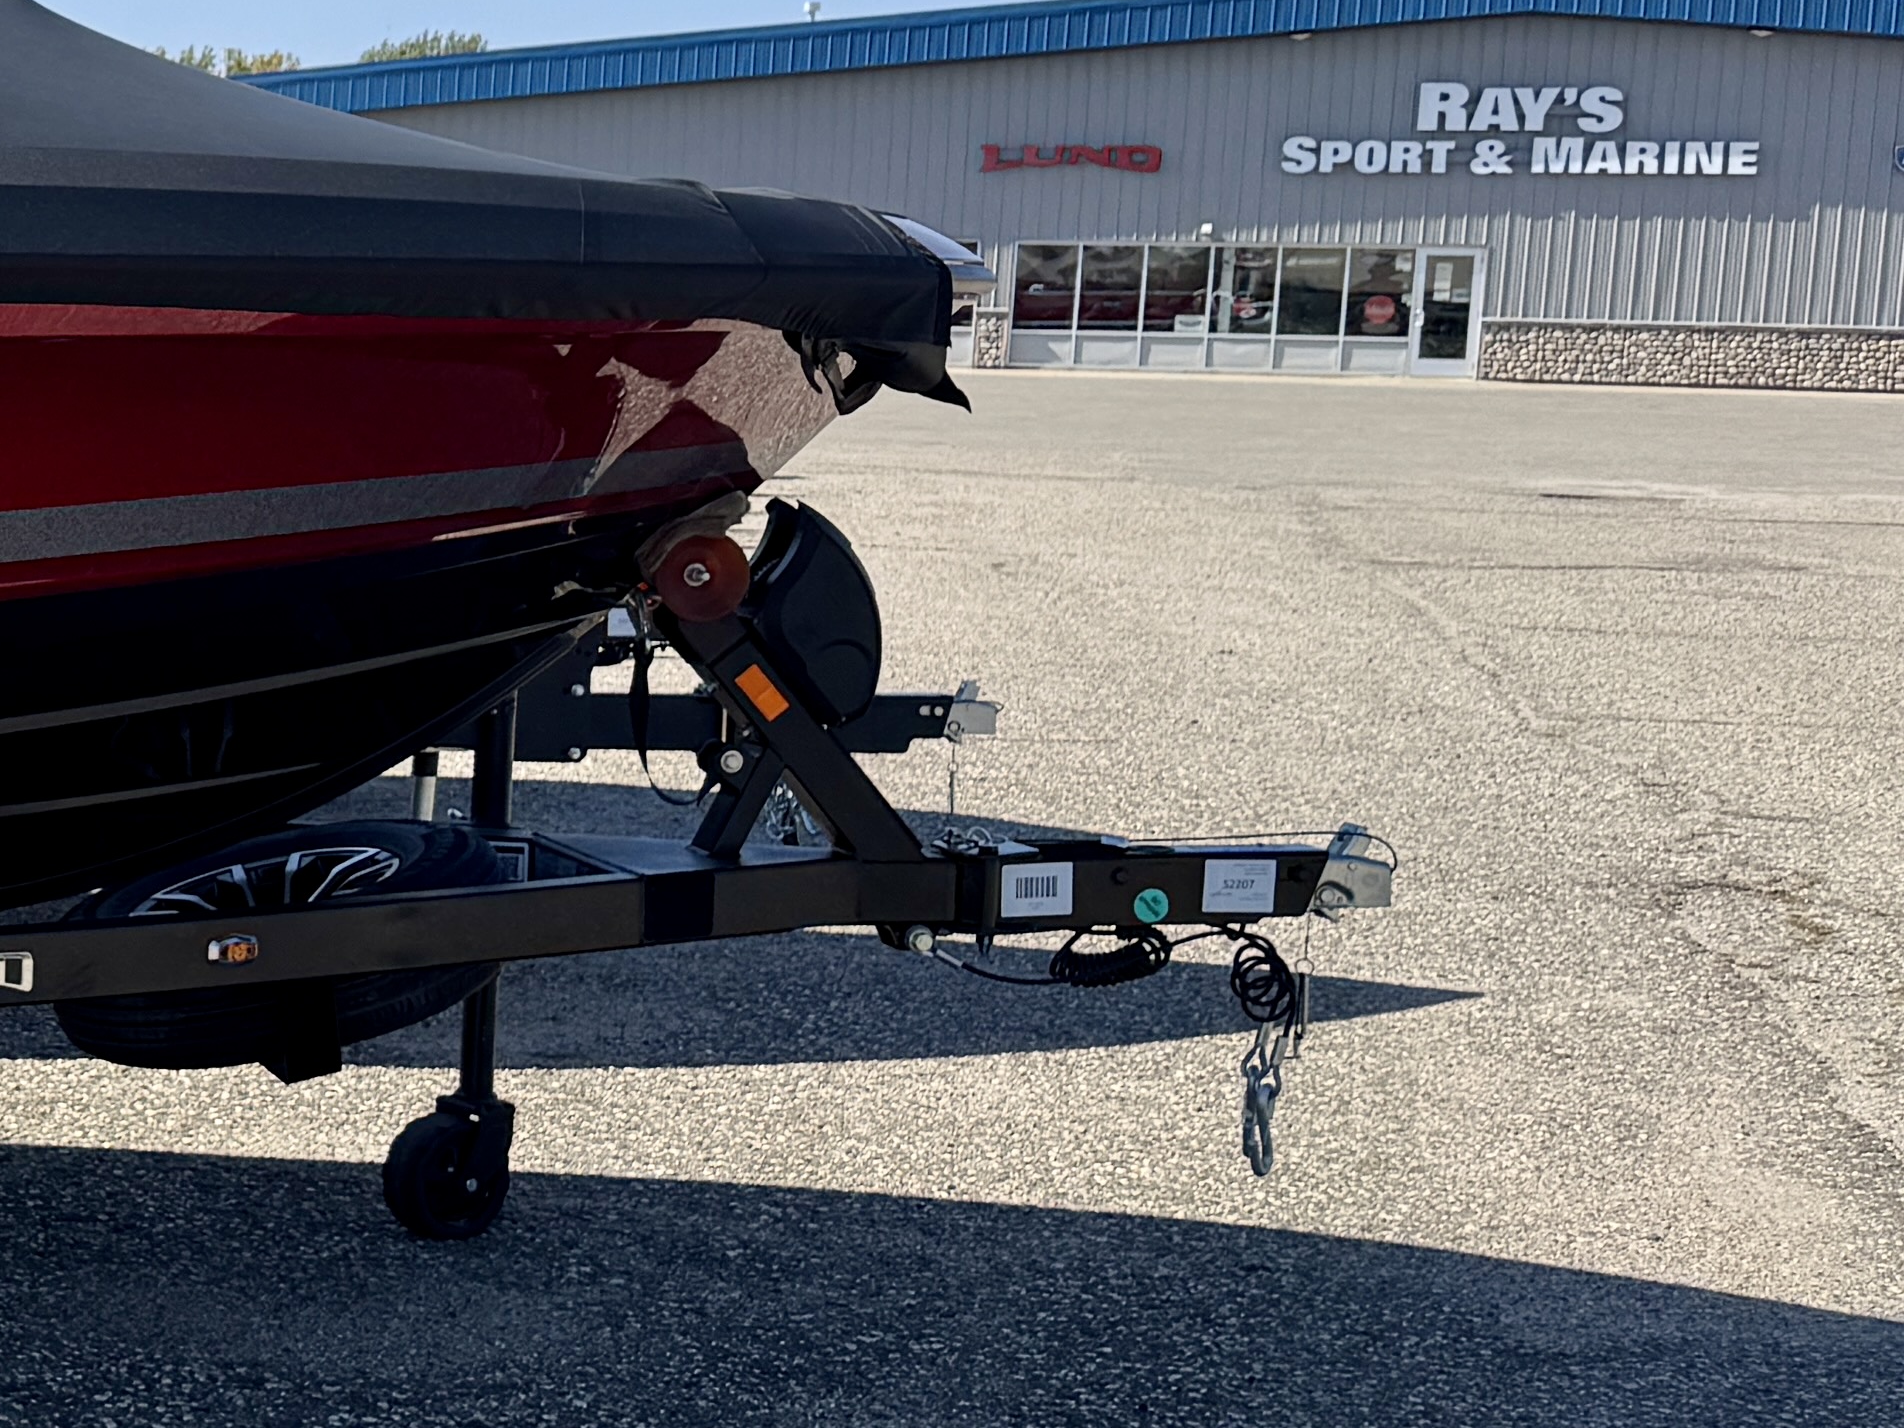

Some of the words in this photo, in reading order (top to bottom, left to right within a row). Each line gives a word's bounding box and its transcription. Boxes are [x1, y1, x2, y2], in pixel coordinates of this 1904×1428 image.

[1416, 82, 1624, 132] RAY'S
[981, 144, 1163, 173] LUND
[1281, 136, 1455, 173] SPORT
[1469, 139, 1514, 174] &
[1531, 137, 1760, 175] MARINE
